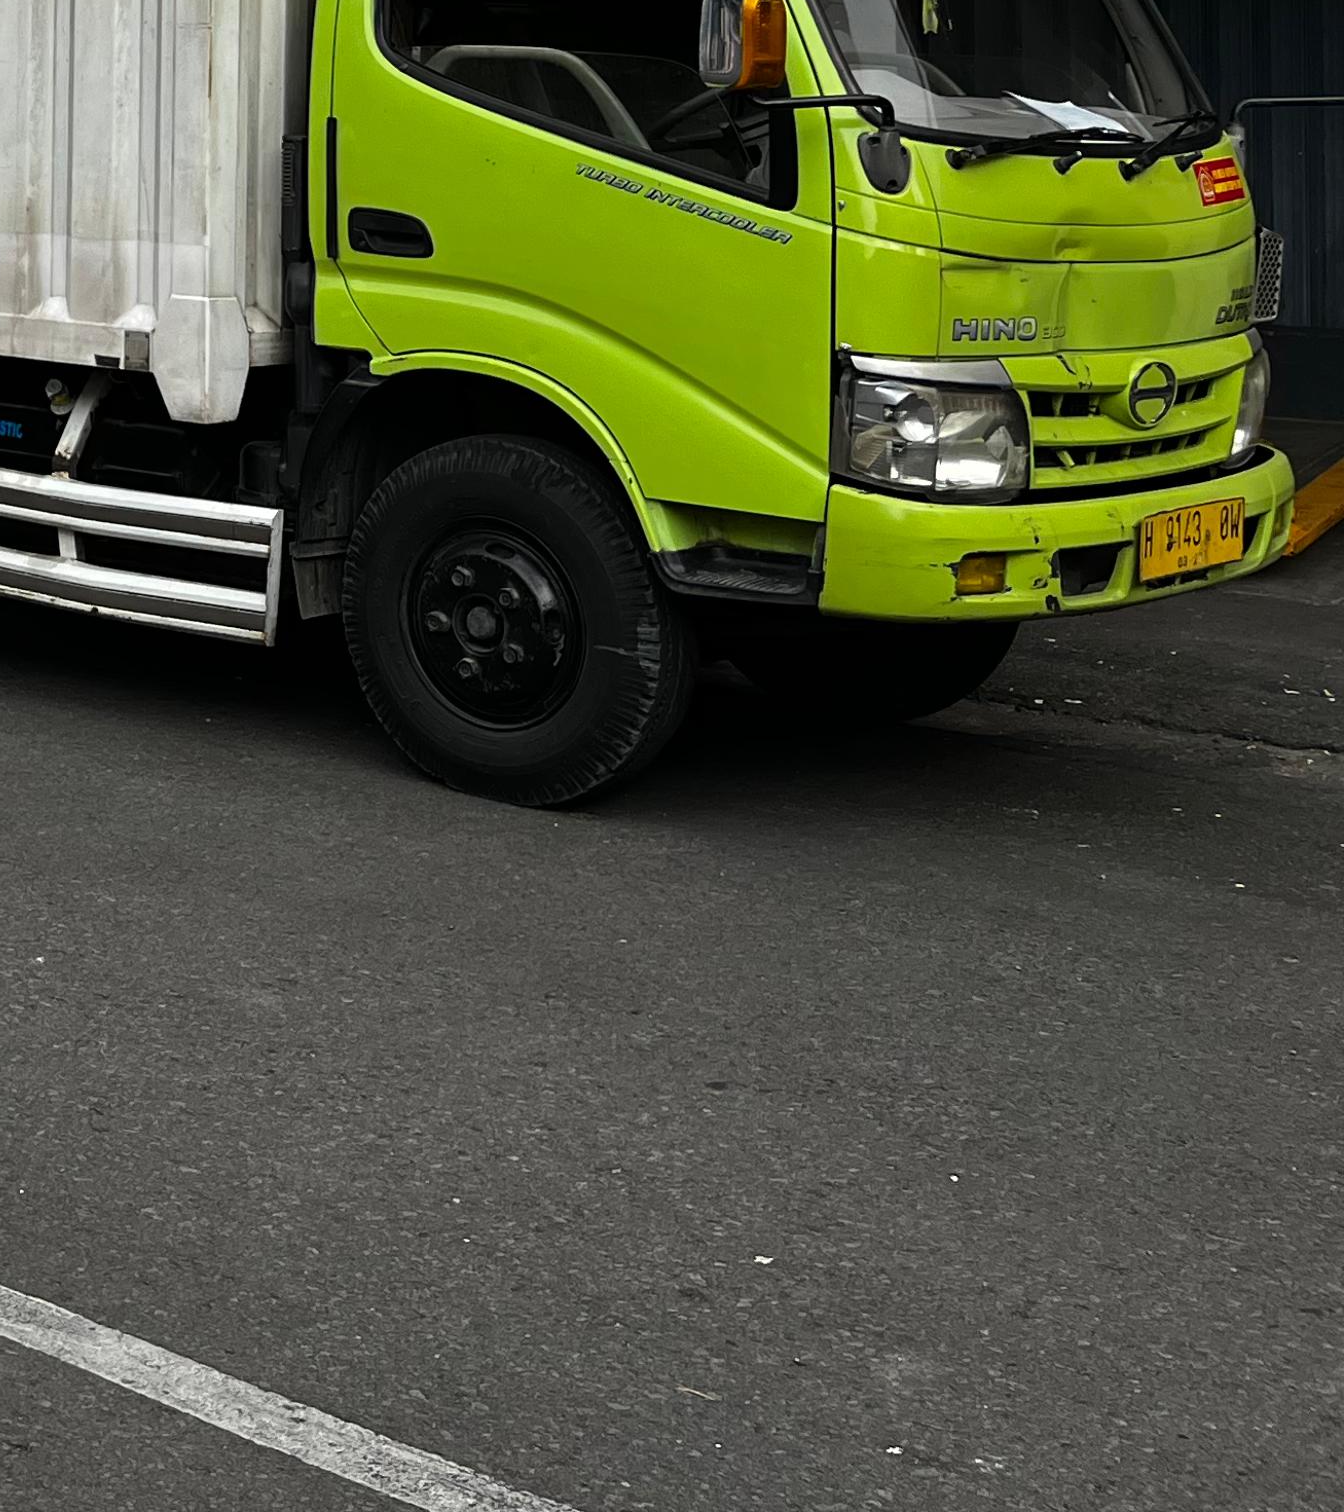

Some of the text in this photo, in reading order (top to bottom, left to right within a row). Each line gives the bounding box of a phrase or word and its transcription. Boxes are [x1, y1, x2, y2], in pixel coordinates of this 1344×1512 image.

[575, 163, 793, 245] TURBO INTERCOOLER
[952, 316, 1038, 342] HINO
[1144, 520, 1154, 559] H
